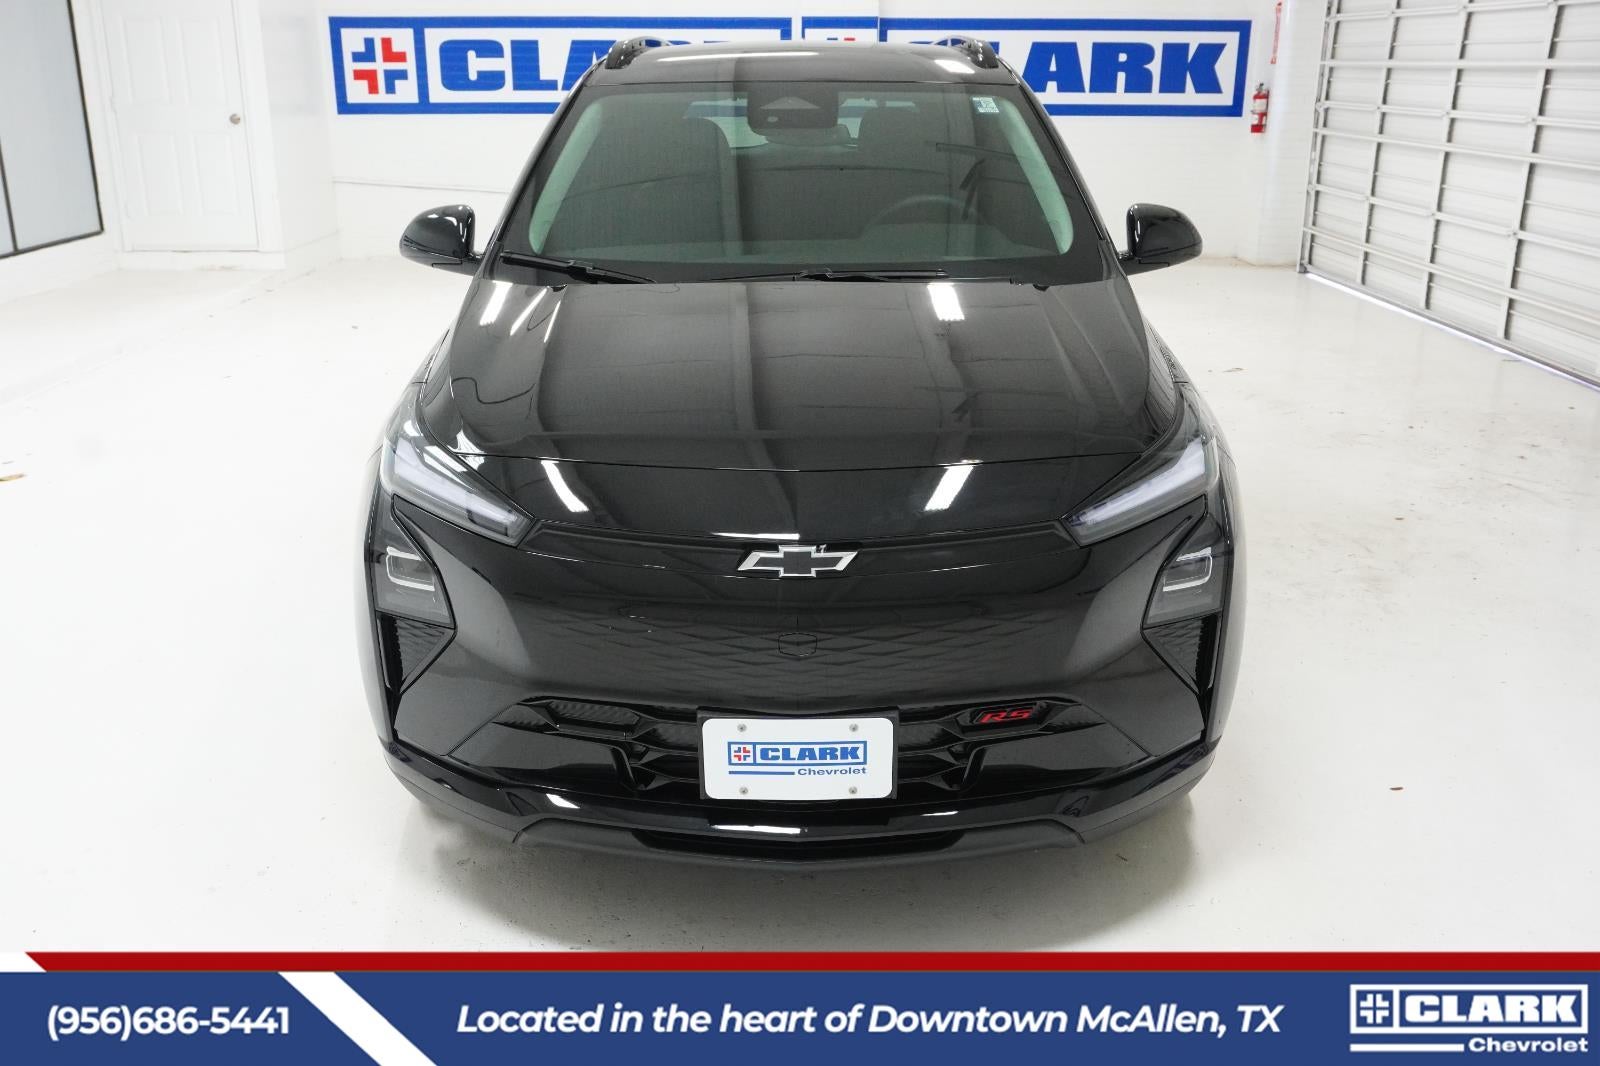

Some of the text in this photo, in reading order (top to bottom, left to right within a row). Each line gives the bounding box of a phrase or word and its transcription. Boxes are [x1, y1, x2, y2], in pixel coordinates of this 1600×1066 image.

[980, 709, 1032, 723] RS
[760, 746, 860, 761] CLARK
[797, 767, 867, 776] Chevrolet
